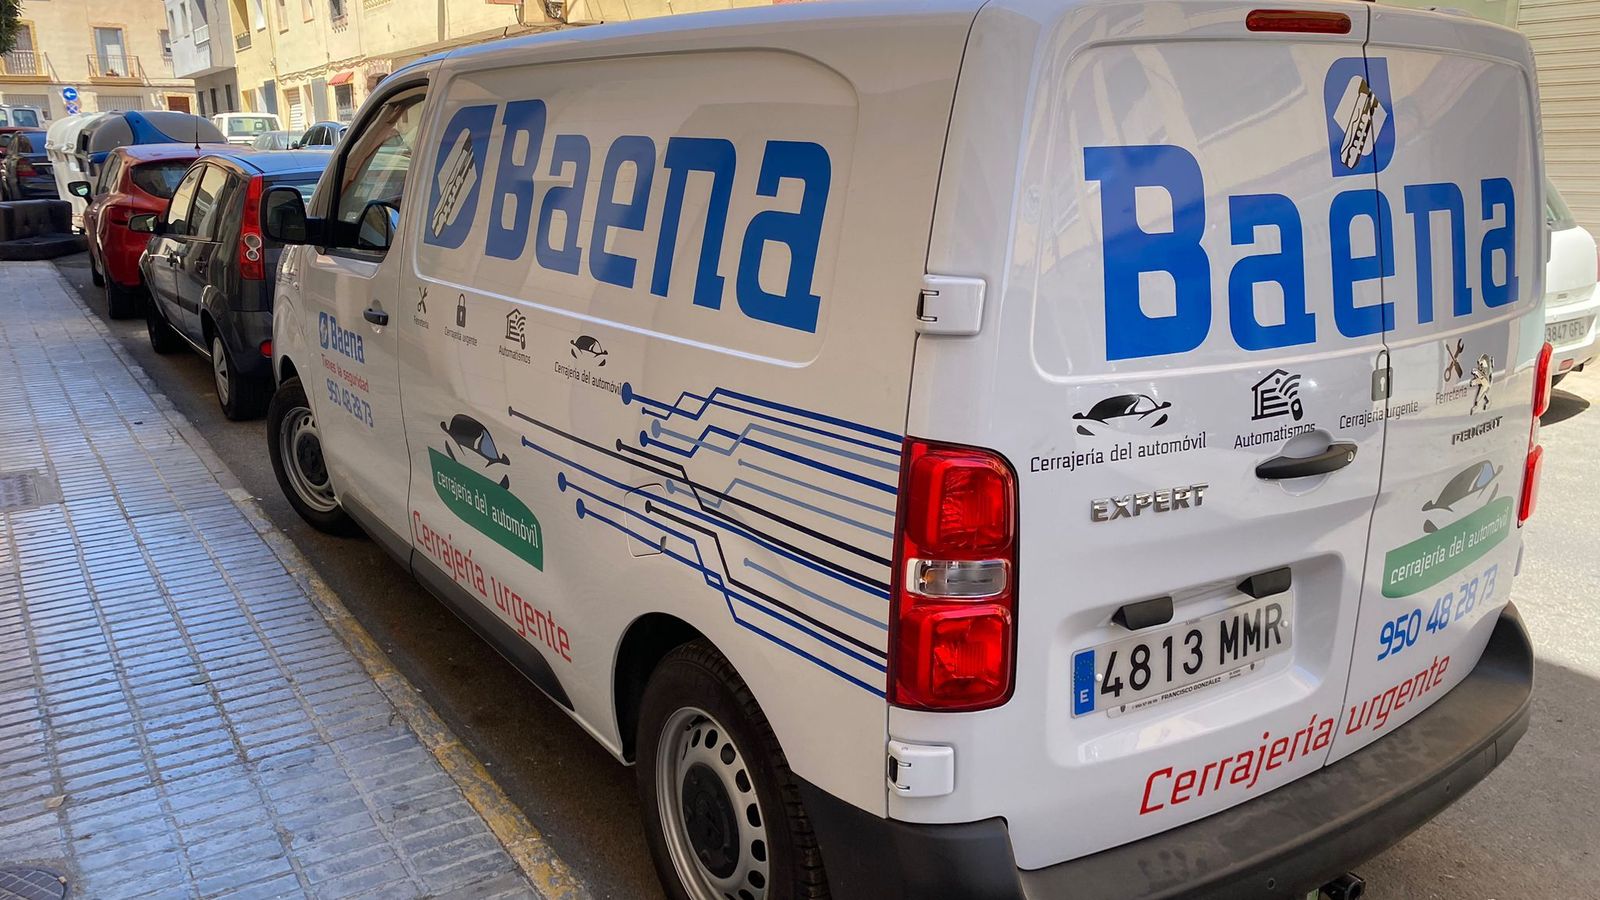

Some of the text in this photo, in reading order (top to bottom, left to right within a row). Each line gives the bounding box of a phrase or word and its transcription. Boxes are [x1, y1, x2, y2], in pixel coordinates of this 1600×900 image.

[485, 99, 831, 333] Baena
[1083, 144, 1519, 362] Baena
[330, 316, 365, 364] Baena
[581, 370, 591, 384] del
[1386, 400, 1419, 421] urgente
[1030, 432, 1207, 473] Cerrajería del automóvil
[1234, 423, 1316, 450] Automatismos
[437, 470, 539, 549] cerrajería del automóvil
[1090, 482, 1210, 523] EXPERT
[1390, 545, 1446, 585] cerrajería
[1449, 531, 1466, 558] del
[412, 510, 573, 663] Cerrajería urgente
[1377, 563, 1498, 662] 950 48 28 73
[1100, 602, 1283, 698] 4813 MMR
[1079, 689, 1090, 704] E
[1161, 685, 1193, 701] FRANCISCO
[1139, 655, 1450, 815] Cerrajería urgente
